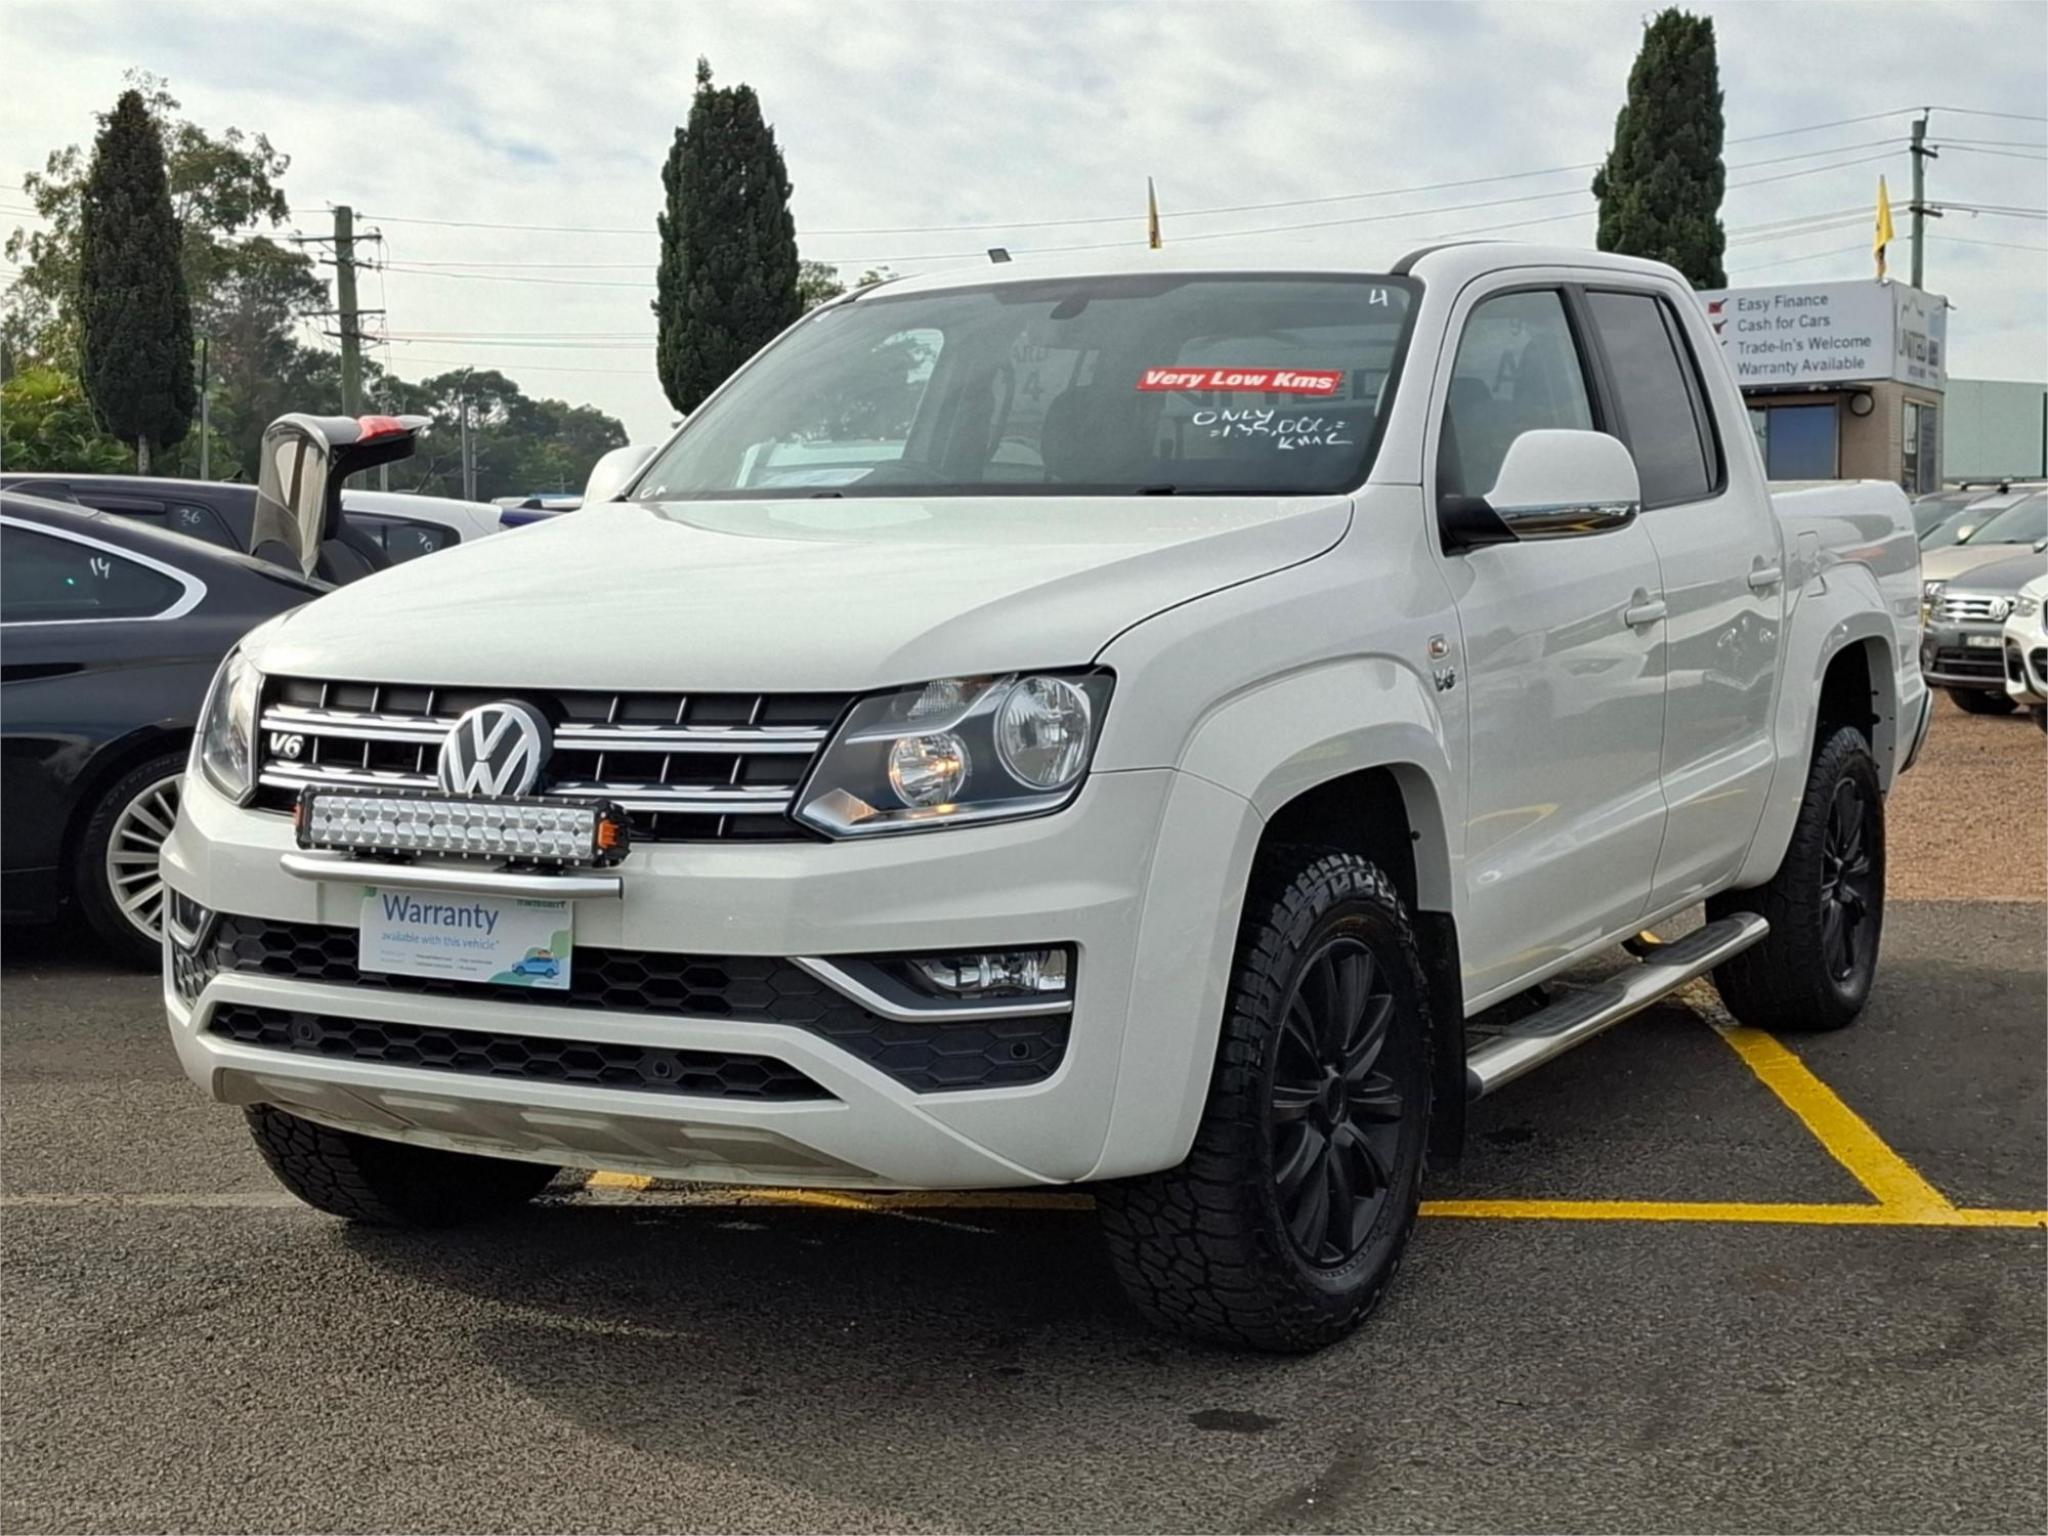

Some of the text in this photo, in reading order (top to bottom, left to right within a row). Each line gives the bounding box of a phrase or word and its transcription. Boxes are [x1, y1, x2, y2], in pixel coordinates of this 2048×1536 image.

[1369, 289, 1388, 306] 4
[1738, 295, 1829, 313] Easy Finance
[1738, 314, 1831, 332] Cash for Cars
[1738, 336, 1872, 354] Trade-In's Welcome
[1737, 356, 1865, 376] Warranty Available
[1145, 371, 1205, 388] Very
[1209, 371, 1267, 386] Low
[1272, 372, 1334, 389] Kms
[1193, 409, 1274, 425] ONLY
[90, 557, 110, 579] 14
[271, 732, 304, 759] V6
[383, 894, 499, 935] Warranty
[421, 934, 441, 945] with
